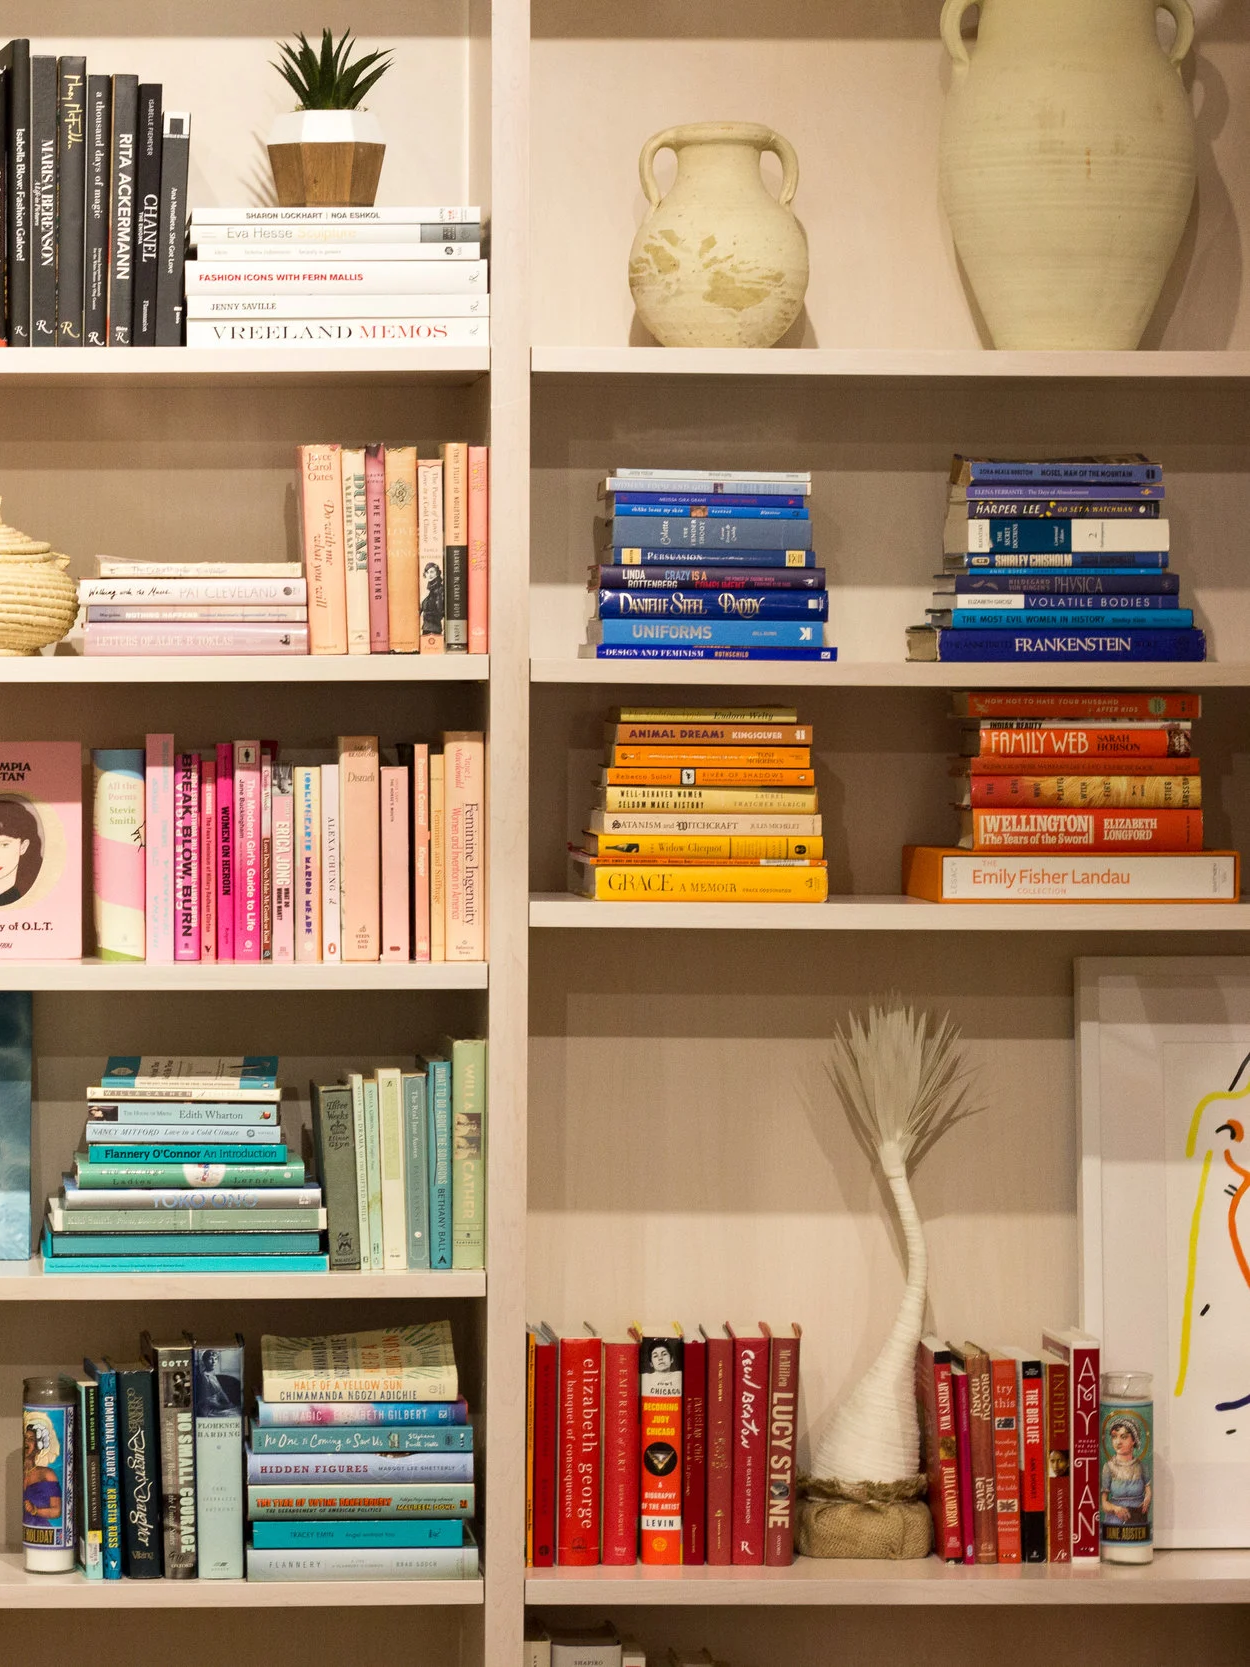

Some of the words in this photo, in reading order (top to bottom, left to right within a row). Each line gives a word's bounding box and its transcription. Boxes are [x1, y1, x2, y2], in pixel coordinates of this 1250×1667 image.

[95, 101, 104, 147] thousand
[16, 129, 25, 162] Isabella
[118, 133, 133, 168] RITA
[41, 141, 54, 192] MARISA
[92, 150, 104, 173] days
[16, 164, 25, 190] Blow:
[94, 176, 104, 185] of
[16, 192, 25, 227] Fashion
[92, 189, 104, 219] magic
[246, 212, 279, 220] SHARON
[281, 212, 323, 220] LOCKHART
[331, 212, 348, 220] NOA
[350, 212, 380, 220] ESHKOL
[41, 195, 54, 267] BERENSON
[116, 173, 132, 280] ACKERMANN
[141, 194, 158, 262] CHANEL
[227, 227, 249, 240] Eva
[253, 226, 293, 240] Hesse
[16, 229, 25, 261] Galore!
[199, 274, 241, 282] FASHION
[244, 274, 274, 282] ICONS
[276, 274, 299, 282] WITH
[302, 274, 327, 282] FERN
[330, 274, 364, 282] MALLIS
[210, 303, 240, 312] JENNY
[242, 303, 277, 311] SAVILLE
[213, 325, 353, 340] VREELAND
[358, 325, 448, 340] MEMOS
[976, 504, 1017, 514] HARPER
[1023, 504, 1041, 514] LEE
[374, 523, 382, 563] FEMALE
[374, 571, 382, 601] THING
[622, 570, 646, 580] LINDA
[628, 580, 678, 589] ROTTENBERG
[619, 593, 669, 614] DANIELLE
[670, 592, 708, 615] STEEL
[718, 592, 766, 619] DADDY
[1029, 597, 1093, 607] VOLATILE
[1101, 597, 1151, 607] BODIES
[632, 625, 712, 639] UNIFORMS
[1015, 636, 1131, 652] FRANKENSTEIN
[629, 730, 676, 738] ANIMAL
[680, 730, 725, 738] DREAMS
[732, 731, 783, 740] KINGSOLVER
[990, 731, 1048, 755] FAMILY
[1052, 732, 1089, 755] WEB
[180, 755, 192, 820] BREAK,
[246, 780, 256, 798] The
[221, 806, 230, 843] WOMEN
[246, 800, 256, 839] Modern
[464, 803, 479, 862] Feminine
[985, 814, 1089, 833] WELLINGTON
[276, 821, 290, 855] ERICA
[181, 826, 192, 880] BLOW,
[222, 846, 230, 859] ON
[246, 841, 256, 866] Girl's
[222, 860, 231, 896] HEROIN
[276, 856, 291, 885] JONG
[608, 874, 674, 892] GRACE
[680, 884, 686, 893] A
[690, 883, 737, 893] MEMOIR
[973, 869, 1017, 889] Emily
[1019, 869, 1068, 886] Fisher
[1072, 869, 1131, 886] Landau
[246, 869, 256, 899] Guide
[462, 865, 479, 926] Ingenuity
[182, 886, 192, 937] BURN
[246, 900, 256, 911] to
[8, 922, 19, 931] of
[22, 922, 54, 931] O.L.T.
[246, 913, 256, 932] Life
[105, 1149, 150, 1160] Flannery
[153, 1148, 201, 1159] O'Connor
[203, 1149, 217, 1158] An
[219, 1148, 277, 1159] Introduction
[582, 1359, 599, 1451] elizabeth
[1026, 1389, 1039, 1406] THE
[1053, 1373, 1067, 1437] INFIDEL
[104, 1396, 115, 1444] COMMUNAL
[177, 1413, 192, 1432] NO
[772, 1392, 794, 1451] LUCY
[1026, 1408, 1039, 1423] BIG
[1027, 1426, 1040, 1444] LIFE
[105, 1446, 116, 1477] LUXURY
[178, 1435, 193, 1484] SMALL
[260, 1465, 310, 1474] HIDDEN
[314, 1464, 368, 1473] FIGURES
[943, 1467, 956, 1490] JULIA
[107, 1488, 117, 1522] KRISTIN
[578, 1462, 594, 1528] george
[945, 1489, 959, 1527] CAMERON
[179, 1487, 195, 1553] COURAGE
[108, 1525, 118, 1547] ROSS
